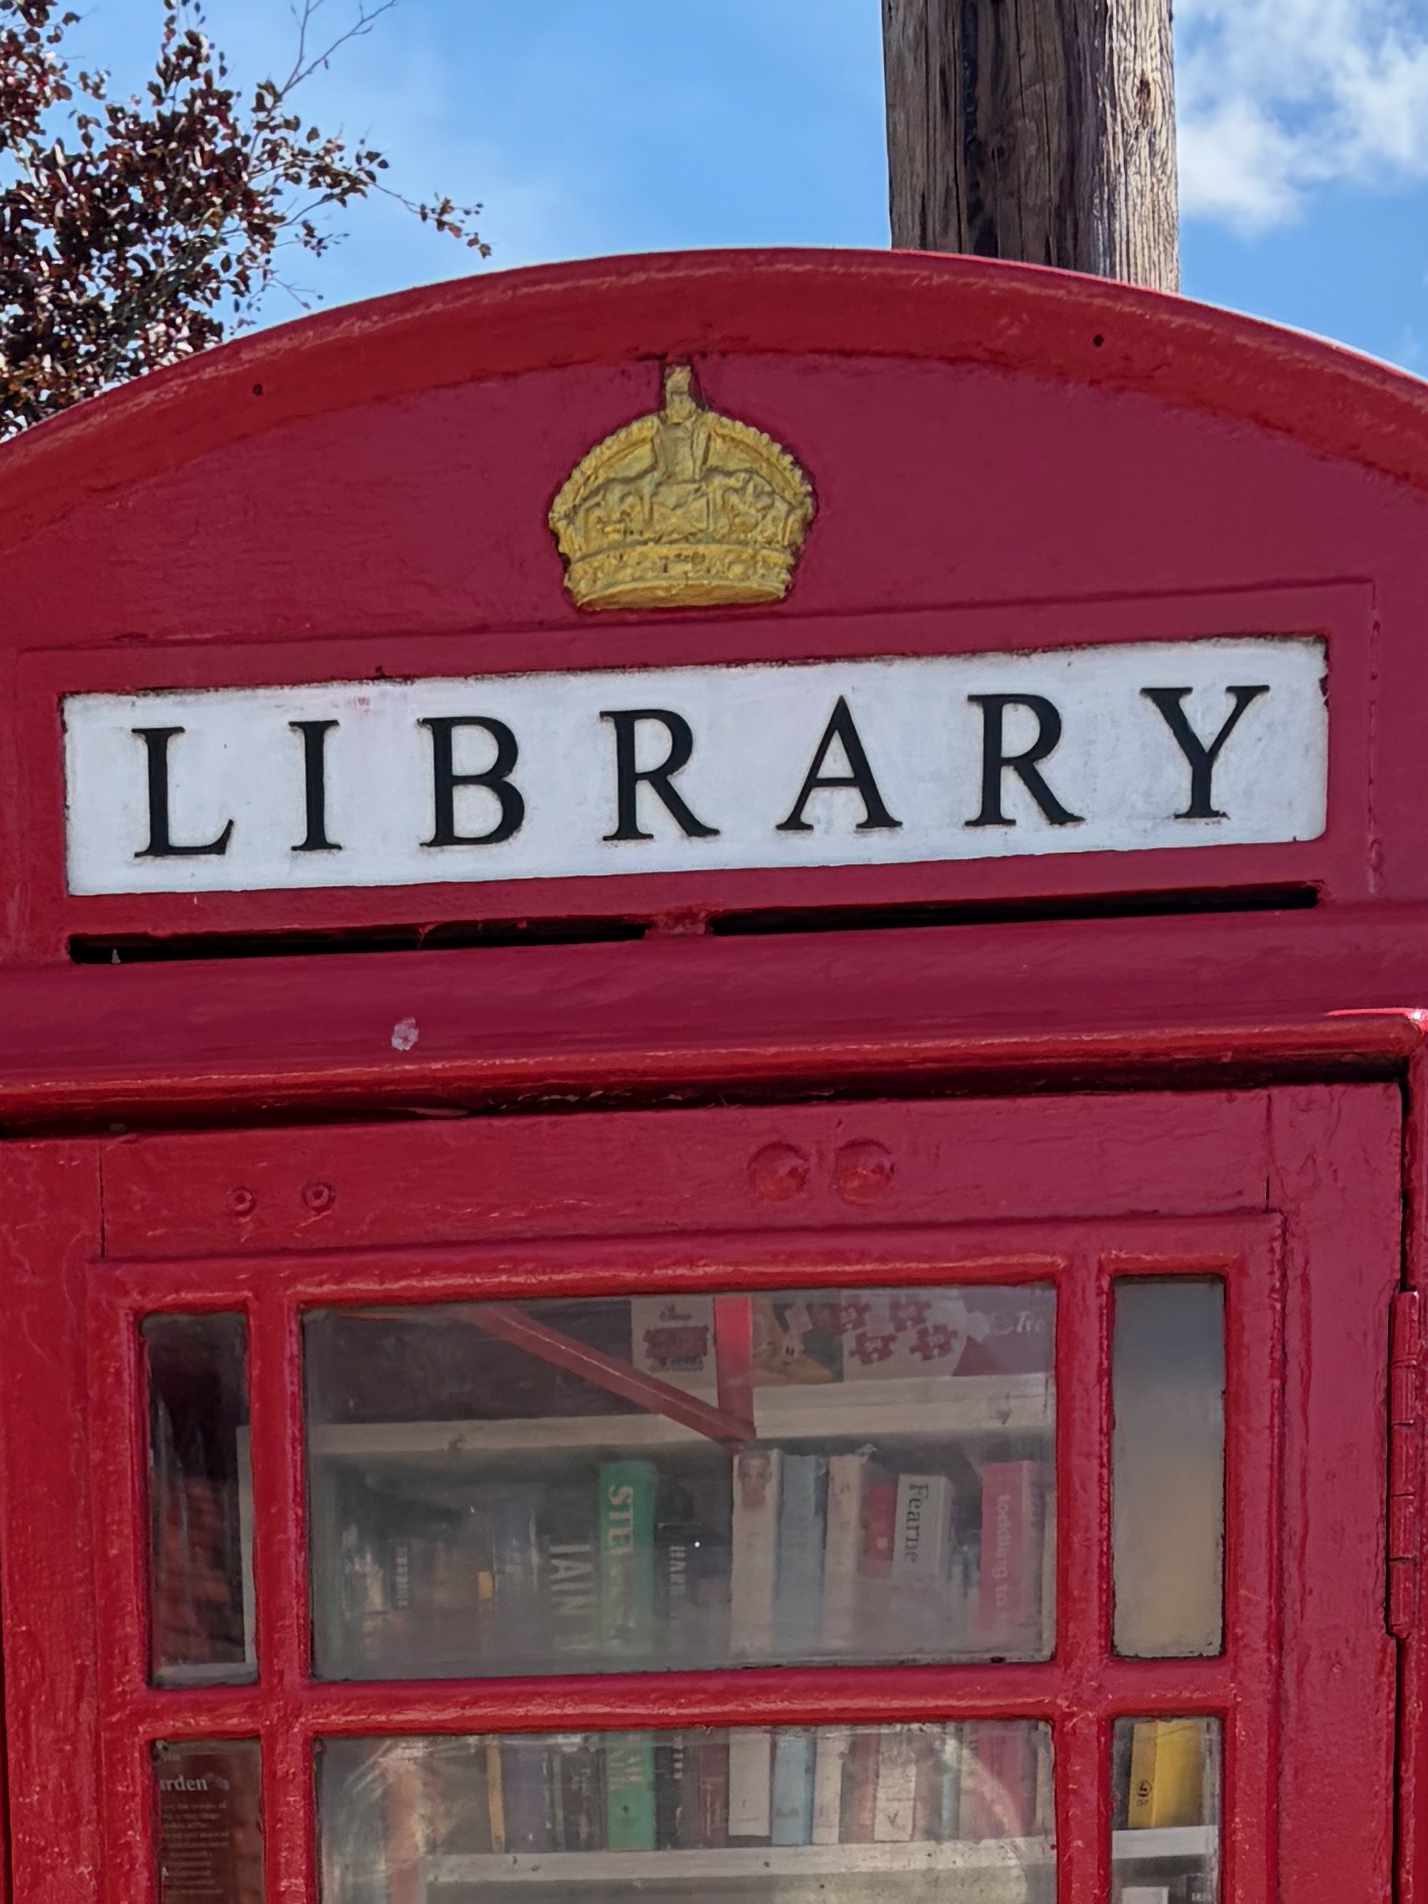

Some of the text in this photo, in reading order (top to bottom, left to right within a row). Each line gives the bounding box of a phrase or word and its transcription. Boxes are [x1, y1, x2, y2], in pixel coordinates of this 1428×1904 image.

[132, 685, 1270, 859] LIBRARY
[904, 1483, 930, 1564] Fearne
[991, 1494, 1012, 1579] toddling
[549, 1543, 595, 1616] IAIN
